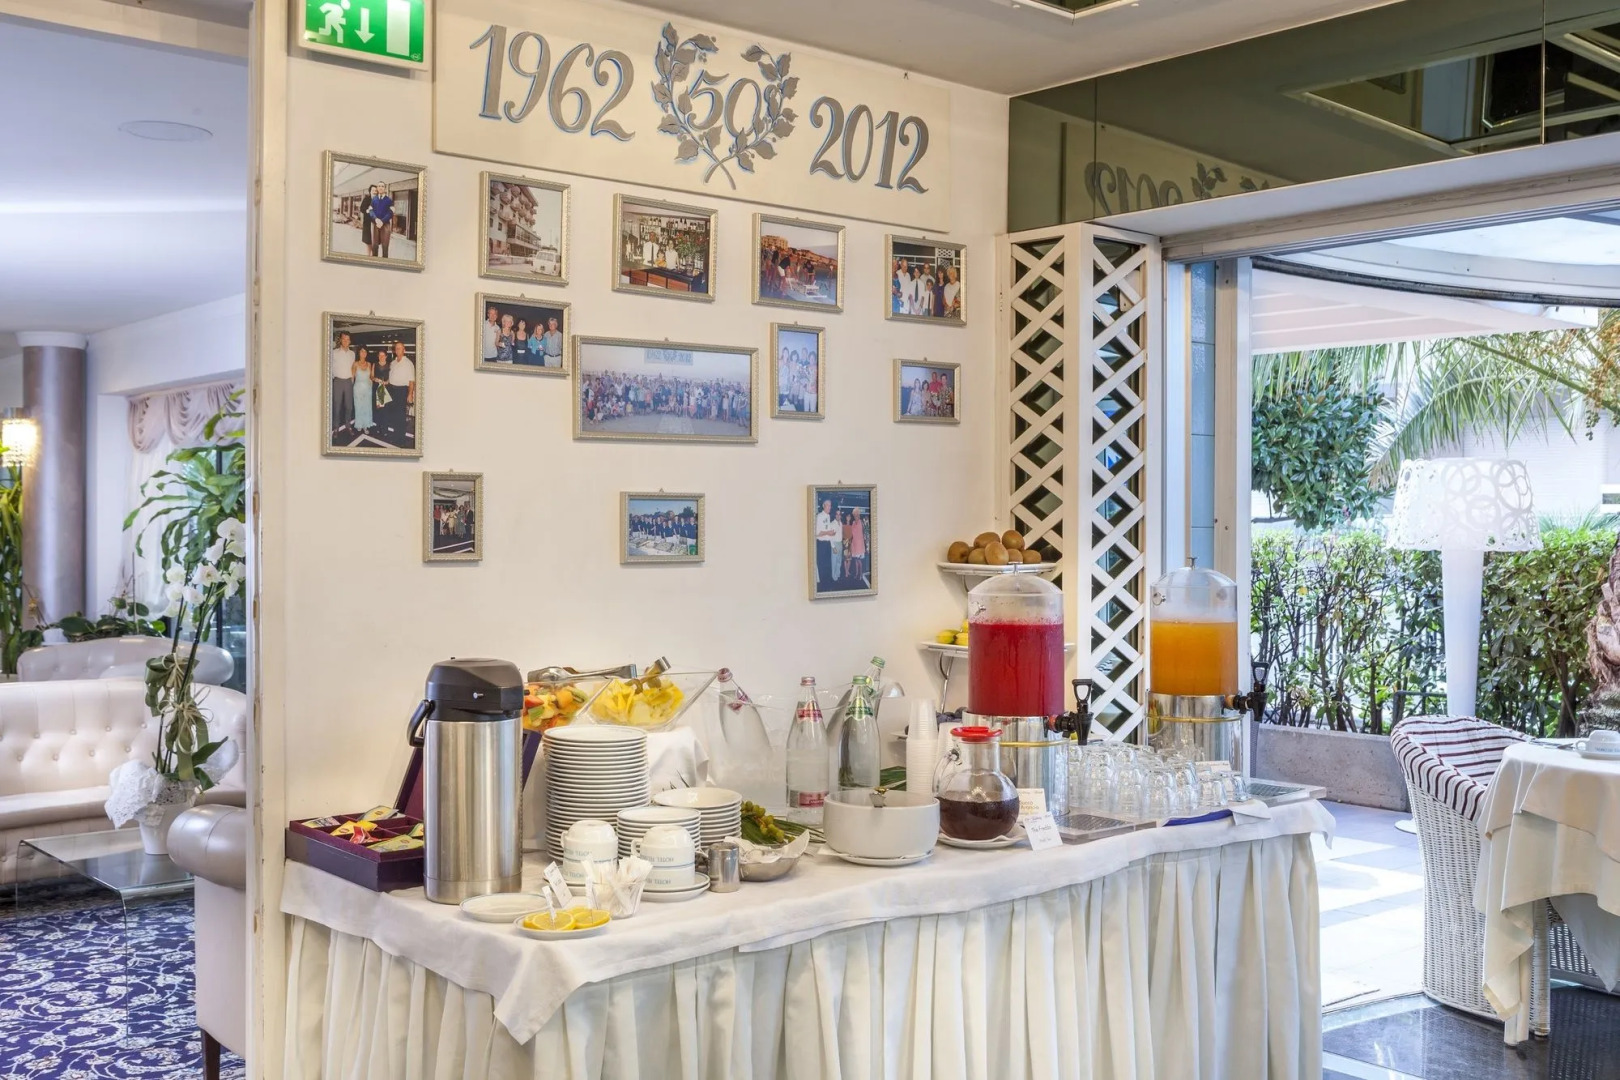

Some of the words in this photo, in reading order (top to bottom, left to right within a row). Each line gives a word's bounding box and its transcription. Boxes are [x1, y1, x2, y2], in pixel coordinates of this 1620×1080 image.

[469, 24, 636, 142] 1962
[686, 69, 762, 138] 50
[810, 96, 930, 194] 2012
